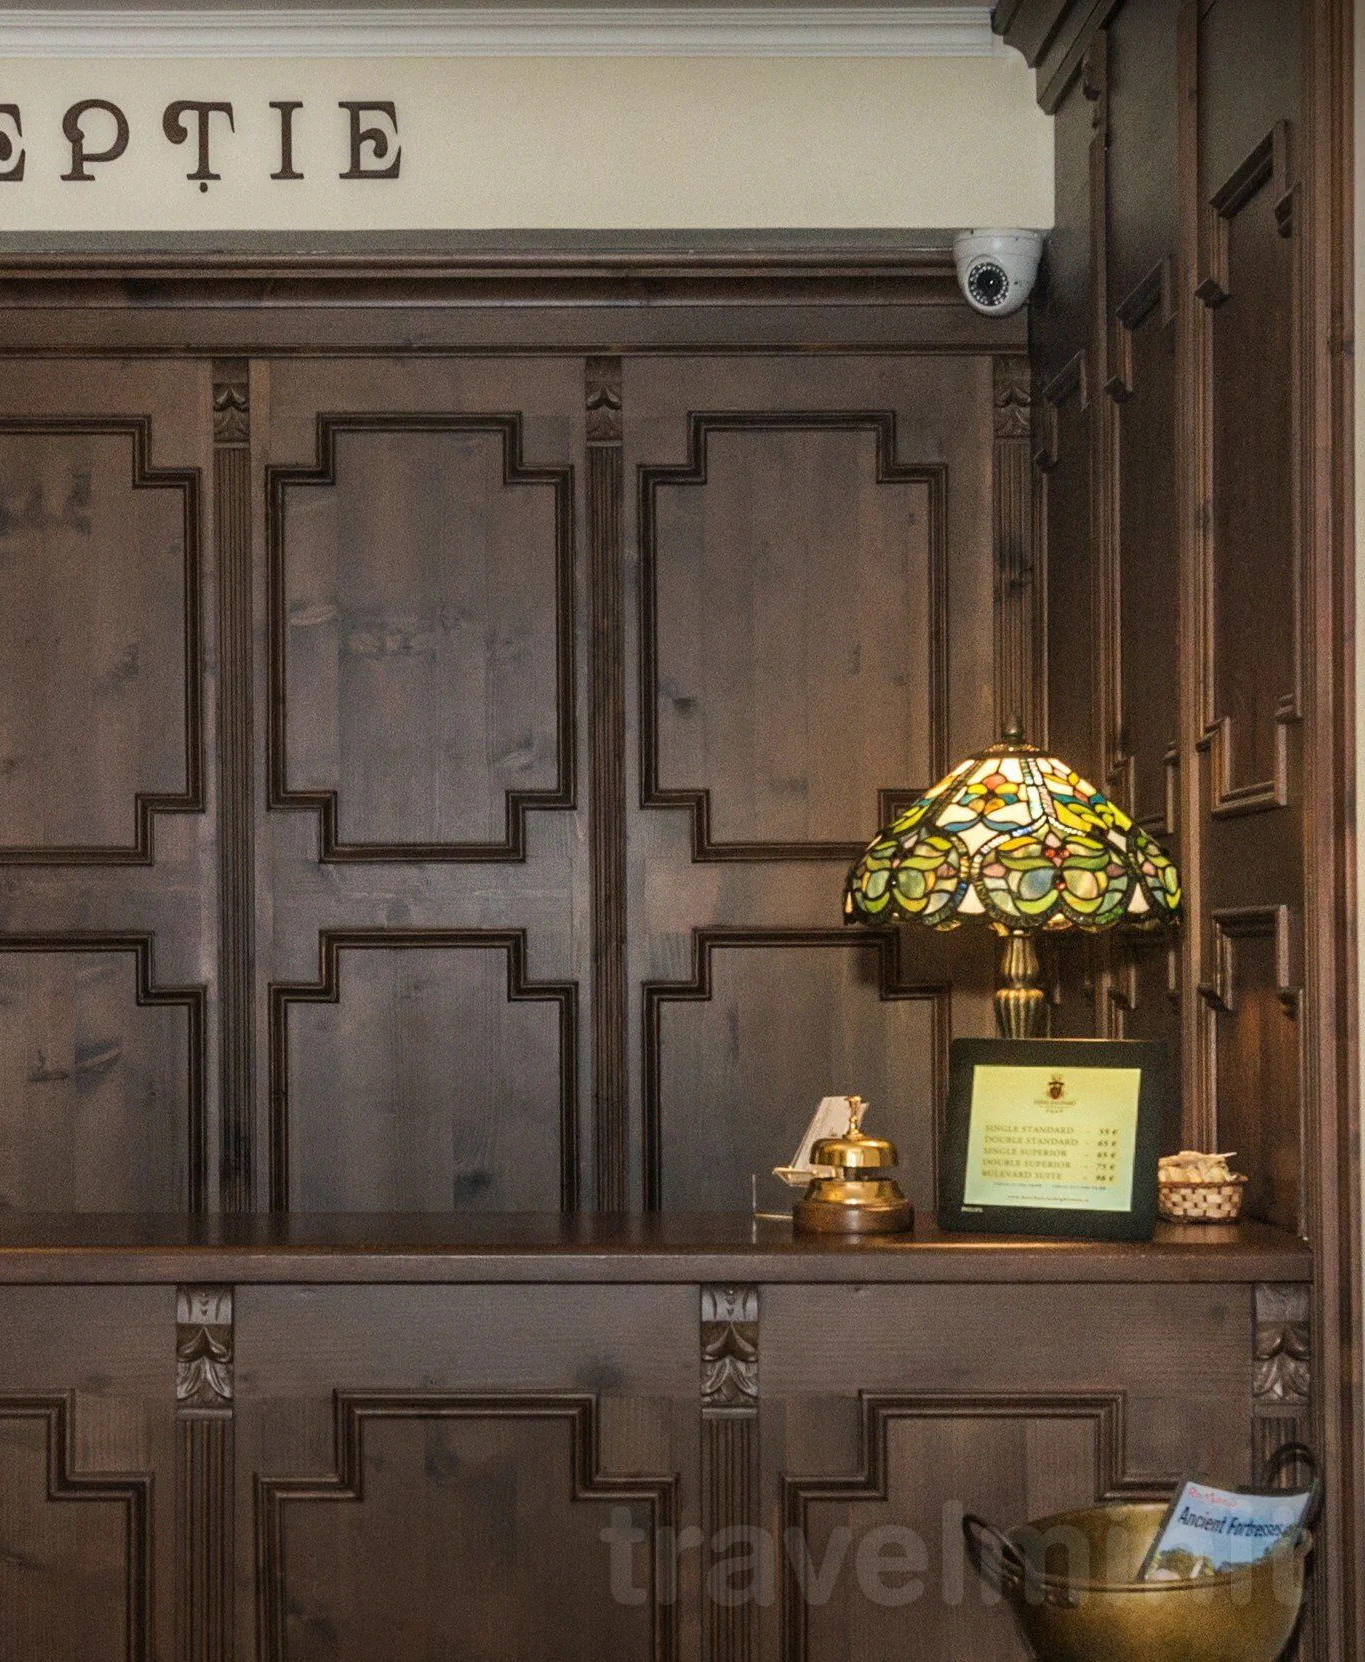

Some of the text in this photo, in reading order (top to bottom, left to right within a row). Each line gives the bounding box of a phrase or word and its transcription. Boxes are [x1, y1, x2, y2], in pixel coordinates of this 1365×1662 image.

[985, 1124, 1019, 1133] SINGLE
[1022, 1125, 1075, 1135] STANDARD
[984, 1136, 1022, 1145] DOUBLE
[1026, 1137, 1079, 1146] STANDARD
[983, 1147, 1018, 1156] SINGLE
[982, 1159, 1020, 1167] DOUBLE
[1178, 1506, 1227, 1536] Ancient
